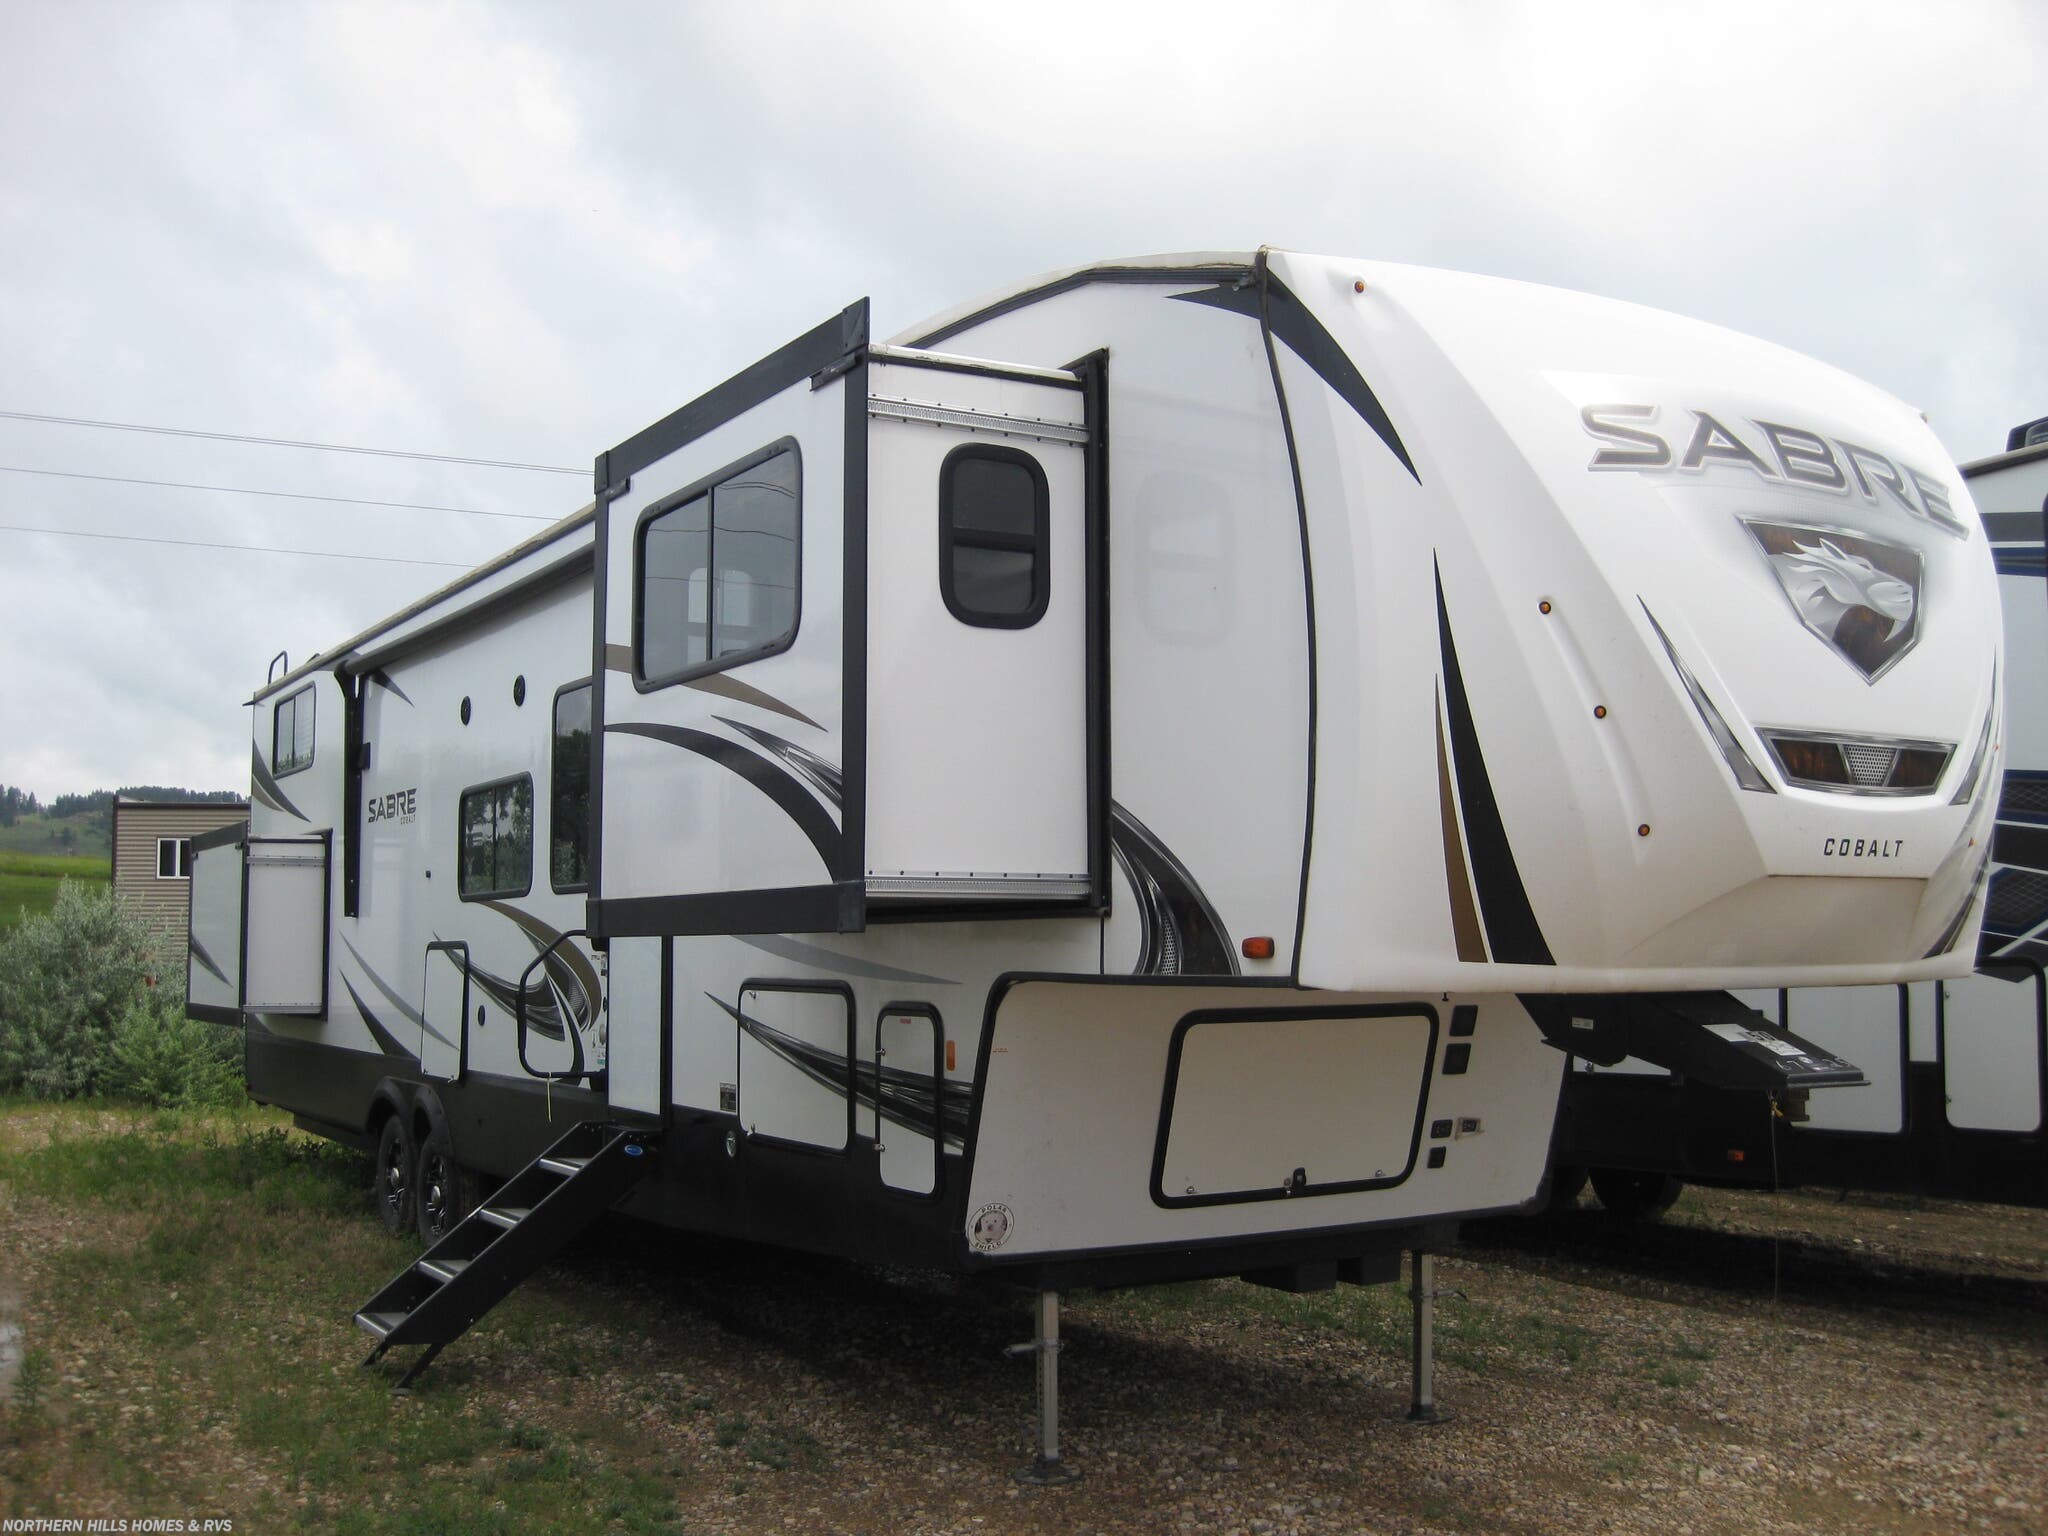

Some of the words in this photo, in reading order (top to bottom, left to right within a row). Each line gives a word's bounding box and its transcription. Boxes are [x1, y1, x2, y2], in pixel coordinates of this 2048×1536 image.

[1580, 404, 1969, 540] SABRE
[368, 788, 417, 823] SABRE
[1823, 838, 1904, 857] COBALT
